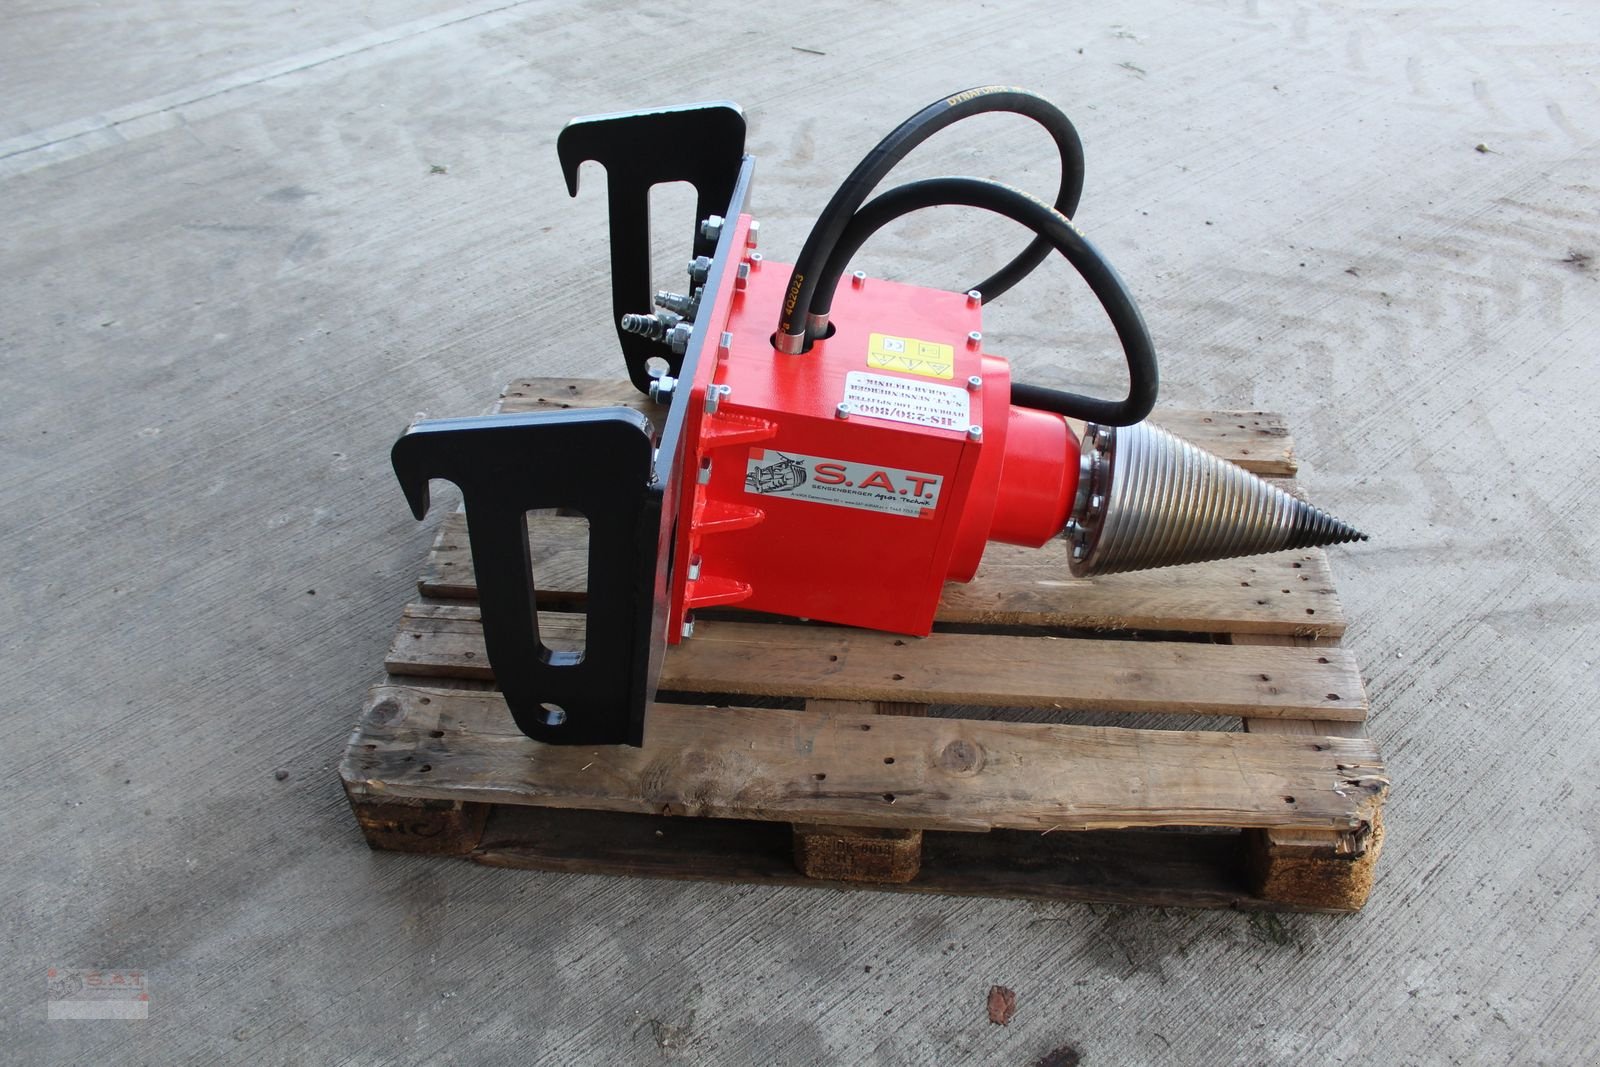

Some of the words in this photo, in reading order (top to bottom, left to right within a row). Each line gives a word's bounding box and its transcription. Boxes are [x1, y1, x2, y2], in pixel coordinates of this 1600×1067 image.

[785, 274, 804, 316] 4Q2023
[850, 384, 930, 402] SENSENBERGER
[811, 484, 873, 496] SENSENBERGER
[900, 497, 931, 505] Technik
[813, 462, 937, 499] S.A.T.
